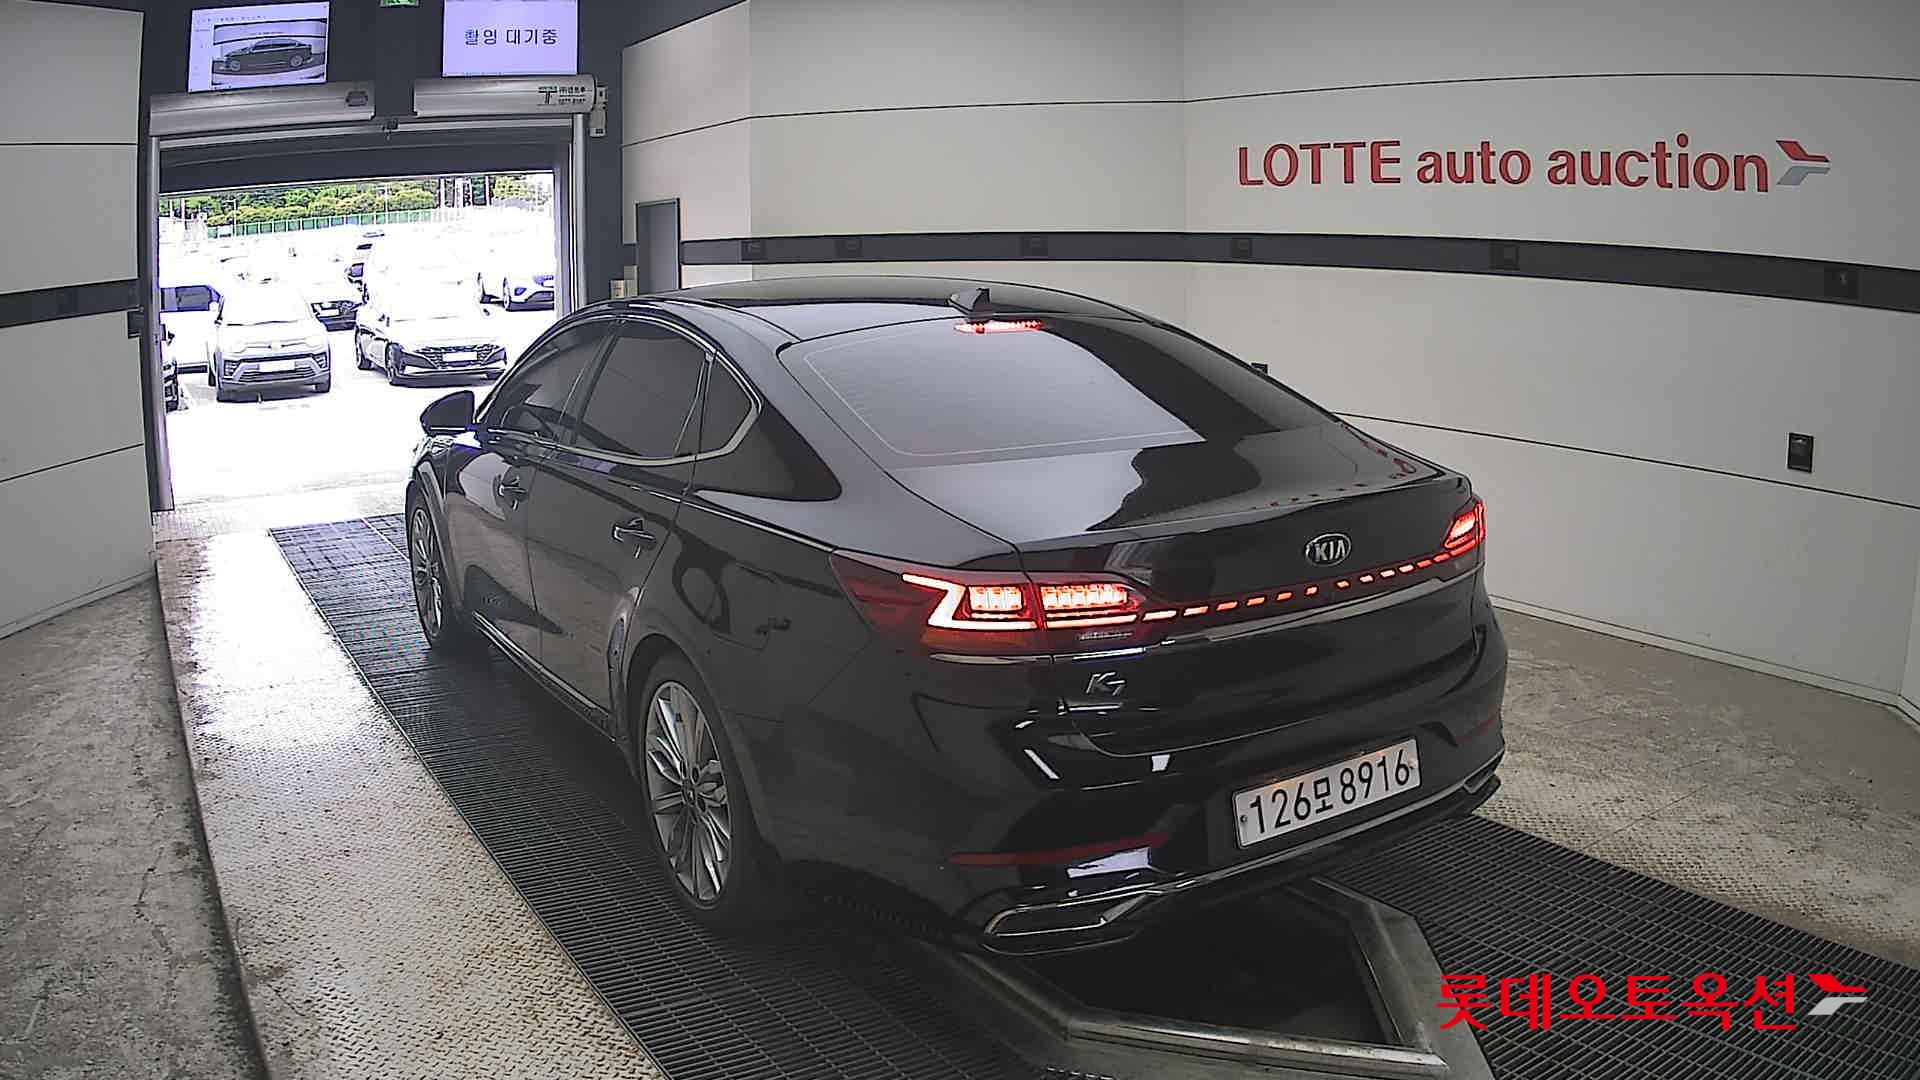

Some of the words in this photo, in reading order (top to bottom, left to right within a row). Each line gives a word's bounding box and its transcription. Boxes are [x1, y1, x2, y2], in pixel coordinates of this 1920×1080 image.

[505, 28, 559, 46] 대기중
[1238, 141, 1401, 187] LOTTE
[1416, 139, 1532, 186] auto
[1547, 133, 1769, 193] auction
[1313, 539, 1346, 563] KIA
[1085, 671, 1126, 697] K7
[1249, 748, 1411, 835] 126모8916
